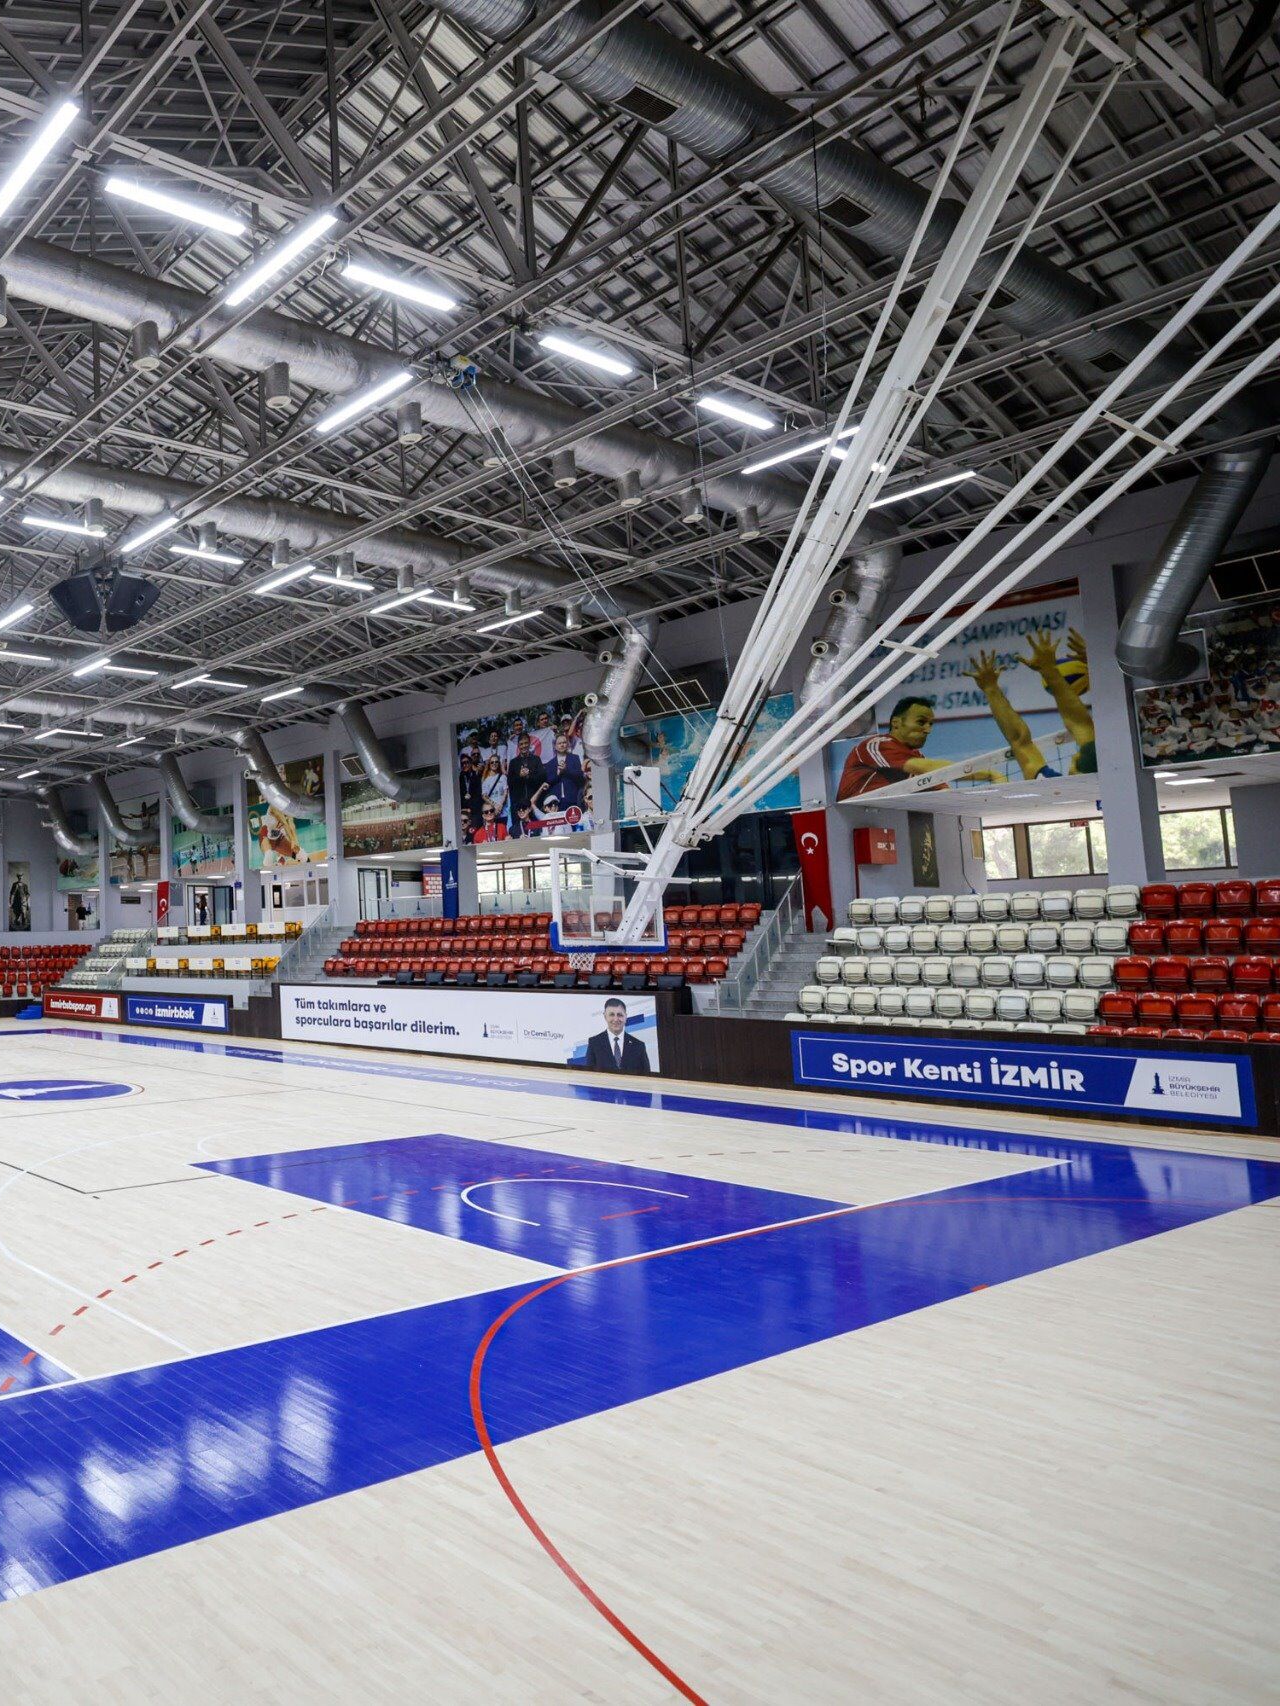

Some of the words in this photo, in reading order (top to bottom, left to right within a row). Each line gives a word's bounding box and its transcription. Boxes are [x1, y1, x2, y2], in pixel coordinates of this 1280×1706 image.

[917, 775, 933, 787] CEV
[154, 1004, 195, 1020] izmirbbsk
[294, 997, 315, 1010] Tüm
[317, 999, 371, 1013] takımlara
[373, 1003, 387, 1013] ve
[295, 1015, 351, 1028] sporculara
[353, 1017, 408, 1033] başarılar
[410, 1020, 461, 1036] dilerim.
[831, 1052, 896, 1079] Spor
[904, 1056, 982, 1084] Kenti
[990, 1056, 1086, 1093] İZMİR
[1169, 1083, 1221, 1093] BÜYÜKŞEHİR
